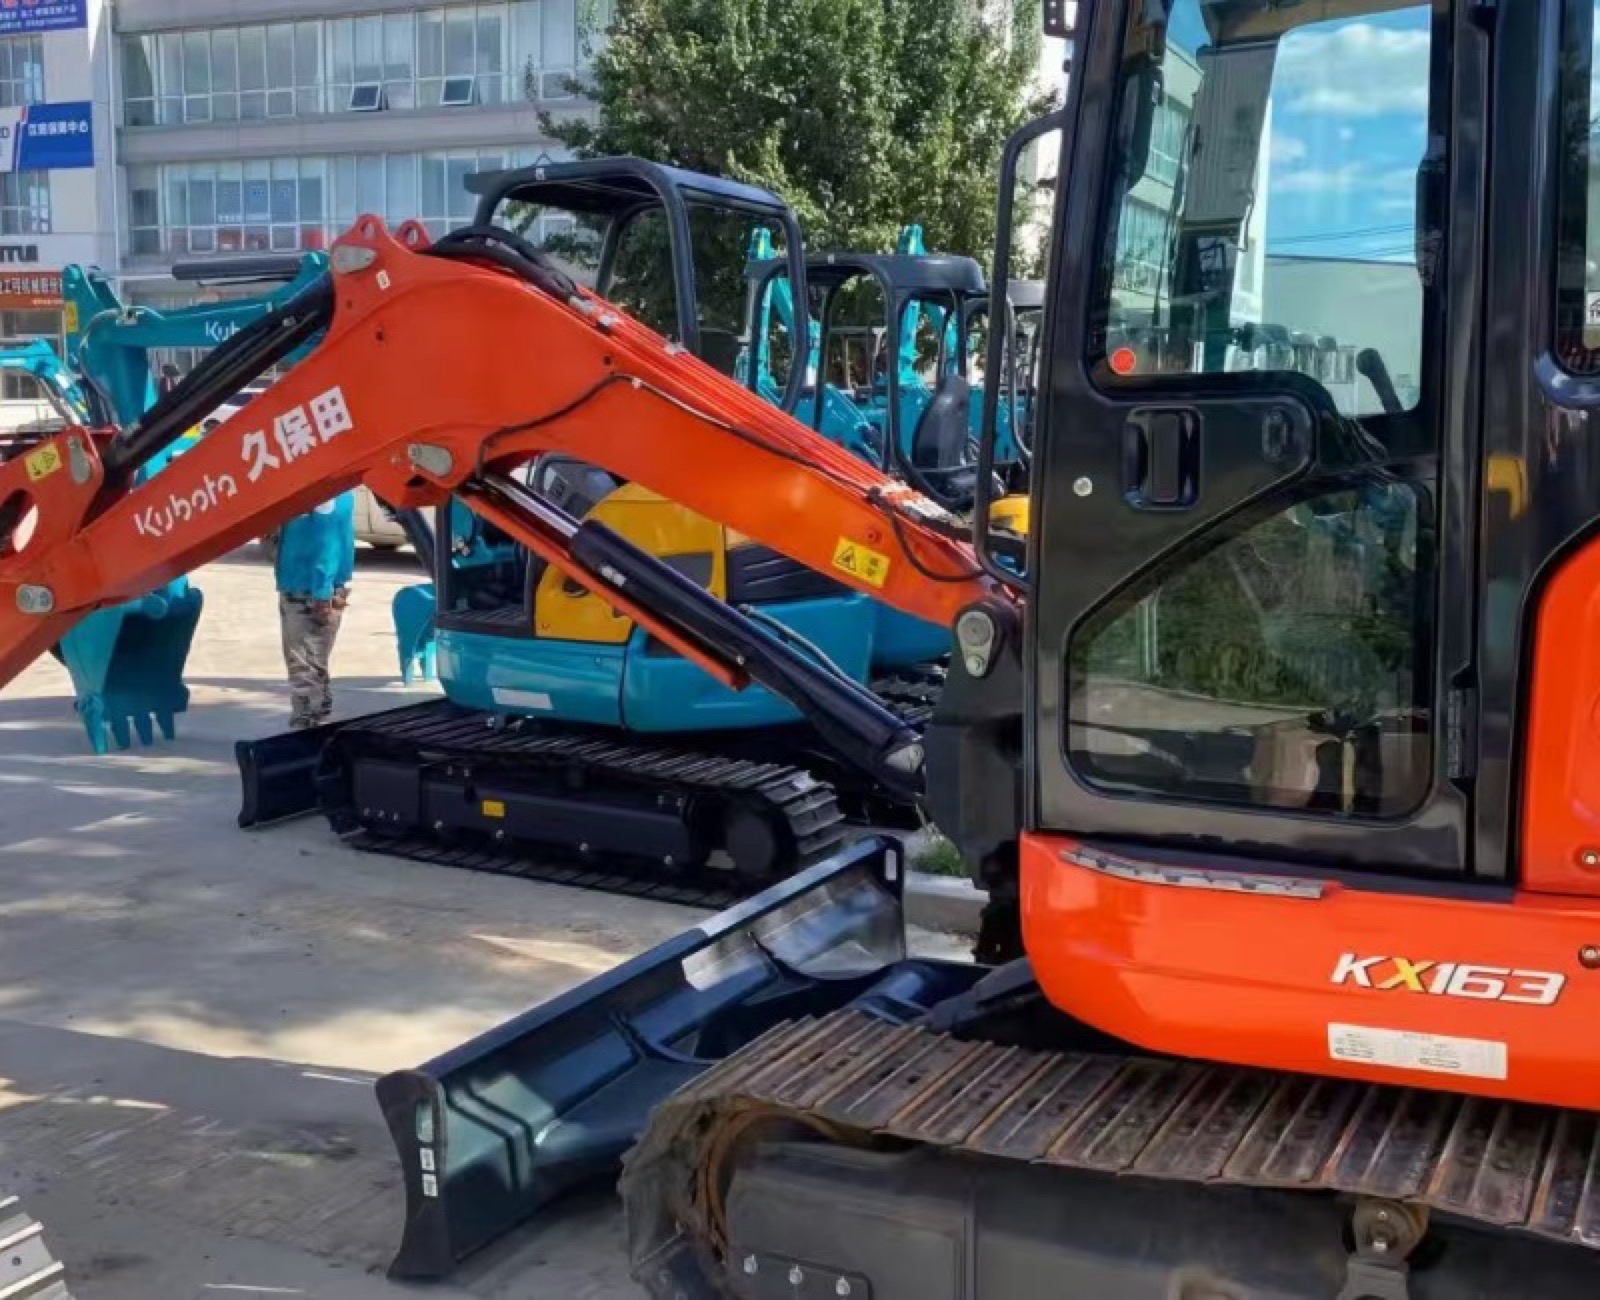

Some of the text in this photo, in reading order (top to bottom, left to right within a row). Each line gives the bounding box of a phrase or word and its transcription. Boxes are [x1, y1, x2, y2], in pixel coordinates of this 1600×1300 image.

[133, 385, 353, 537] Kubota 久保田
[1330, 952, 1567, 1006] KX163
